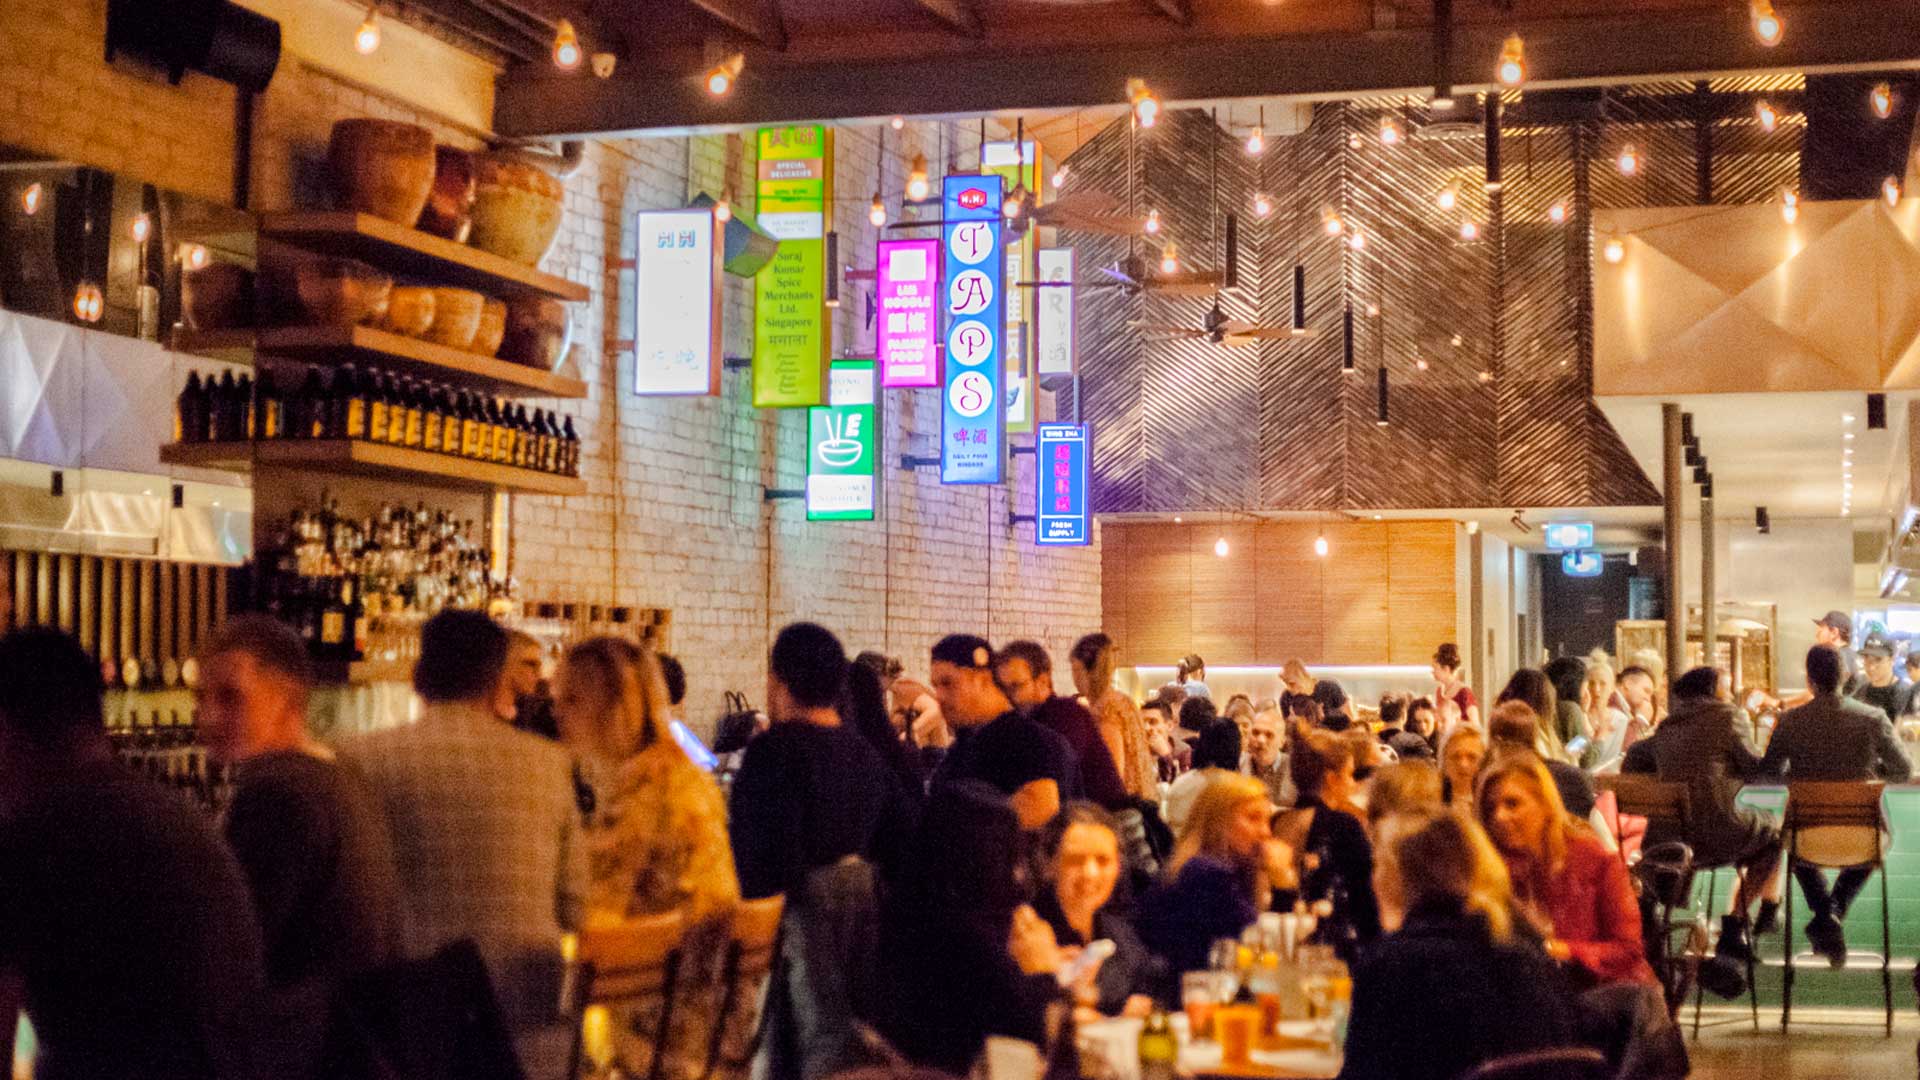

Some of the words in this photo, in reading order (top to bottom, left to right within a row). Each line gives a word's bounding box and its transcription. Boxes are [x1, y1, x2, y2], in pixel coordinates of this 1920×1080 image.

[777, 252, 803, 262] Suraj
[774, 264, 804, 273] Kumar
[777, 278, 801, 288] Spice
[765, 290, 814, 300] Merchants
[883, 296, 931, 308] NOODLE
[780, 304, 798, 313] Ltd.
[954, 223, 987, 411] TAPS
[765, 317, 813, 329] Singapore
